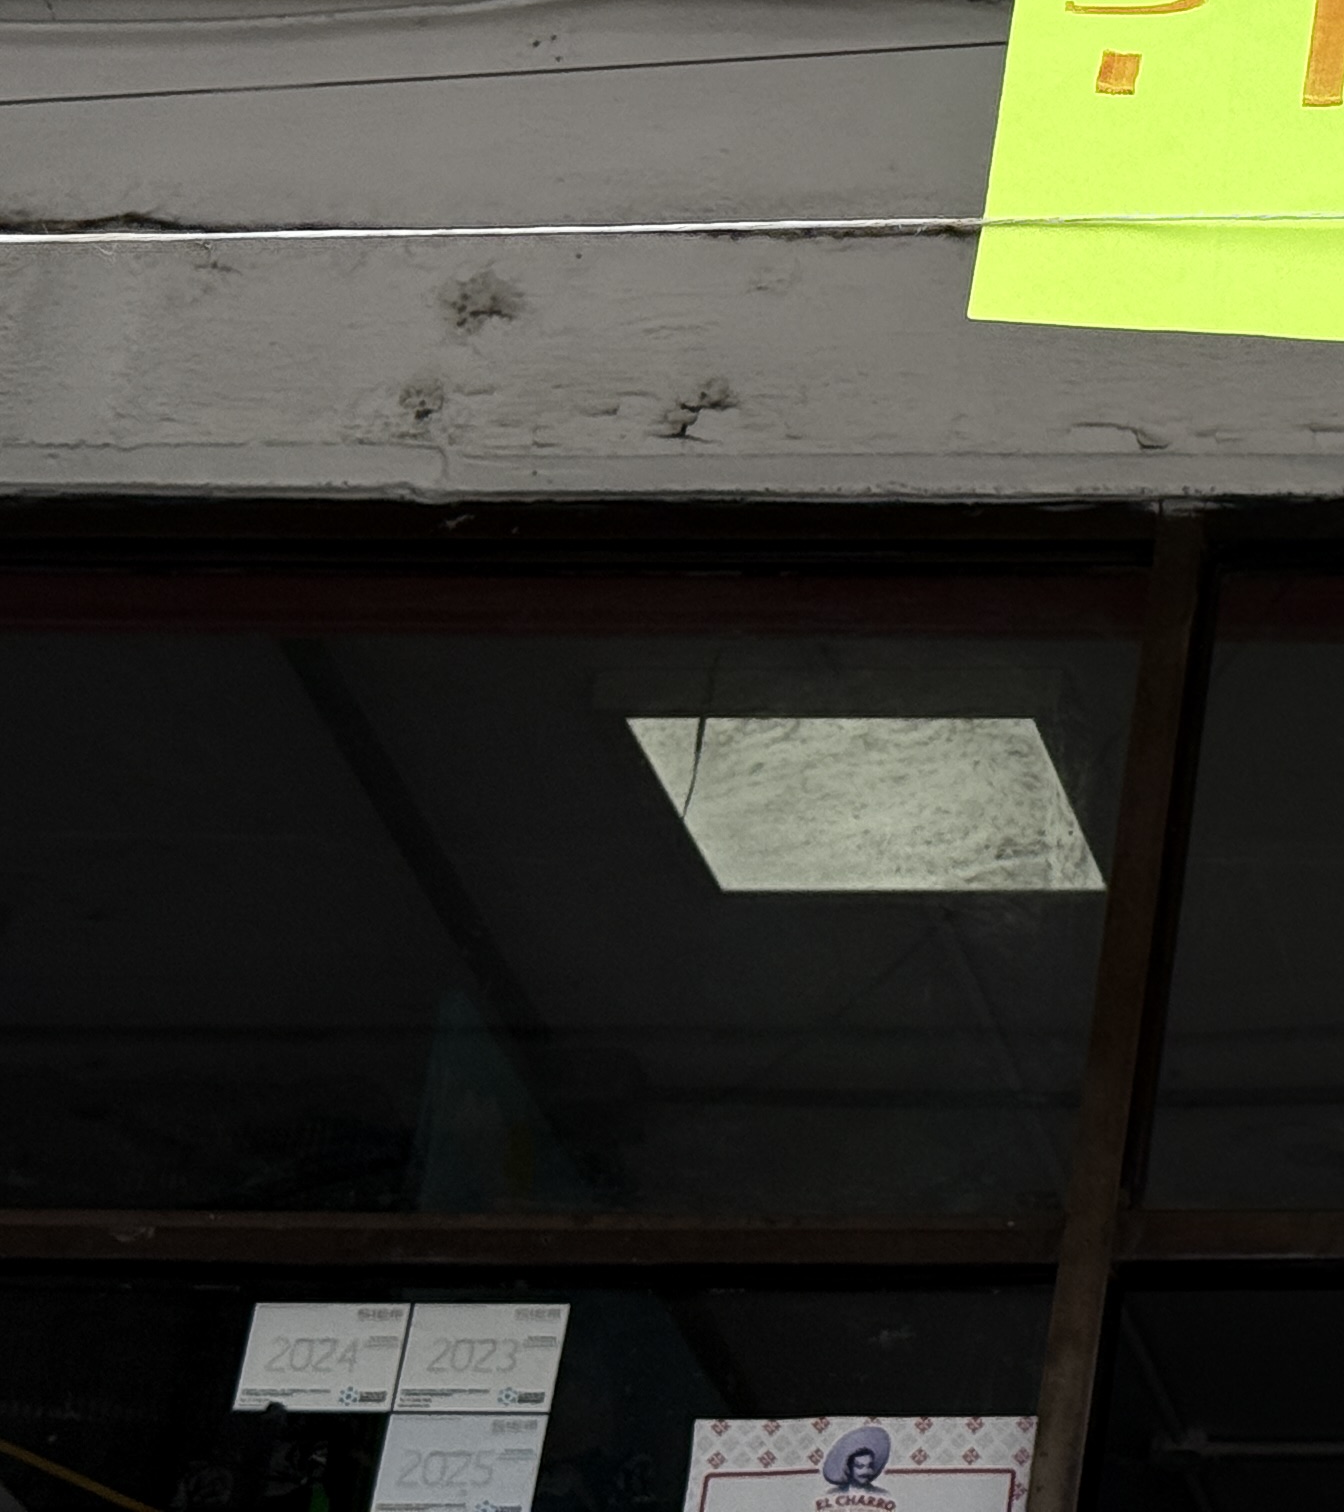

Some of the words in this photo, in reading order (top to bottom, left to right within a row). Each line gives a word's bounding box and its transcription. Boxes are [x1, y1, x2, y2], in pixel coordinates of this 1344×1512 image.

[263, 1337, 361, 1374] 2024
[426, 1338, 524, 1374] 2023
[396, 1449, 495, 1487] 2025
[816, 1498, 833, 1510] EL
[835, 1495, 897, 1511] CHARRO
